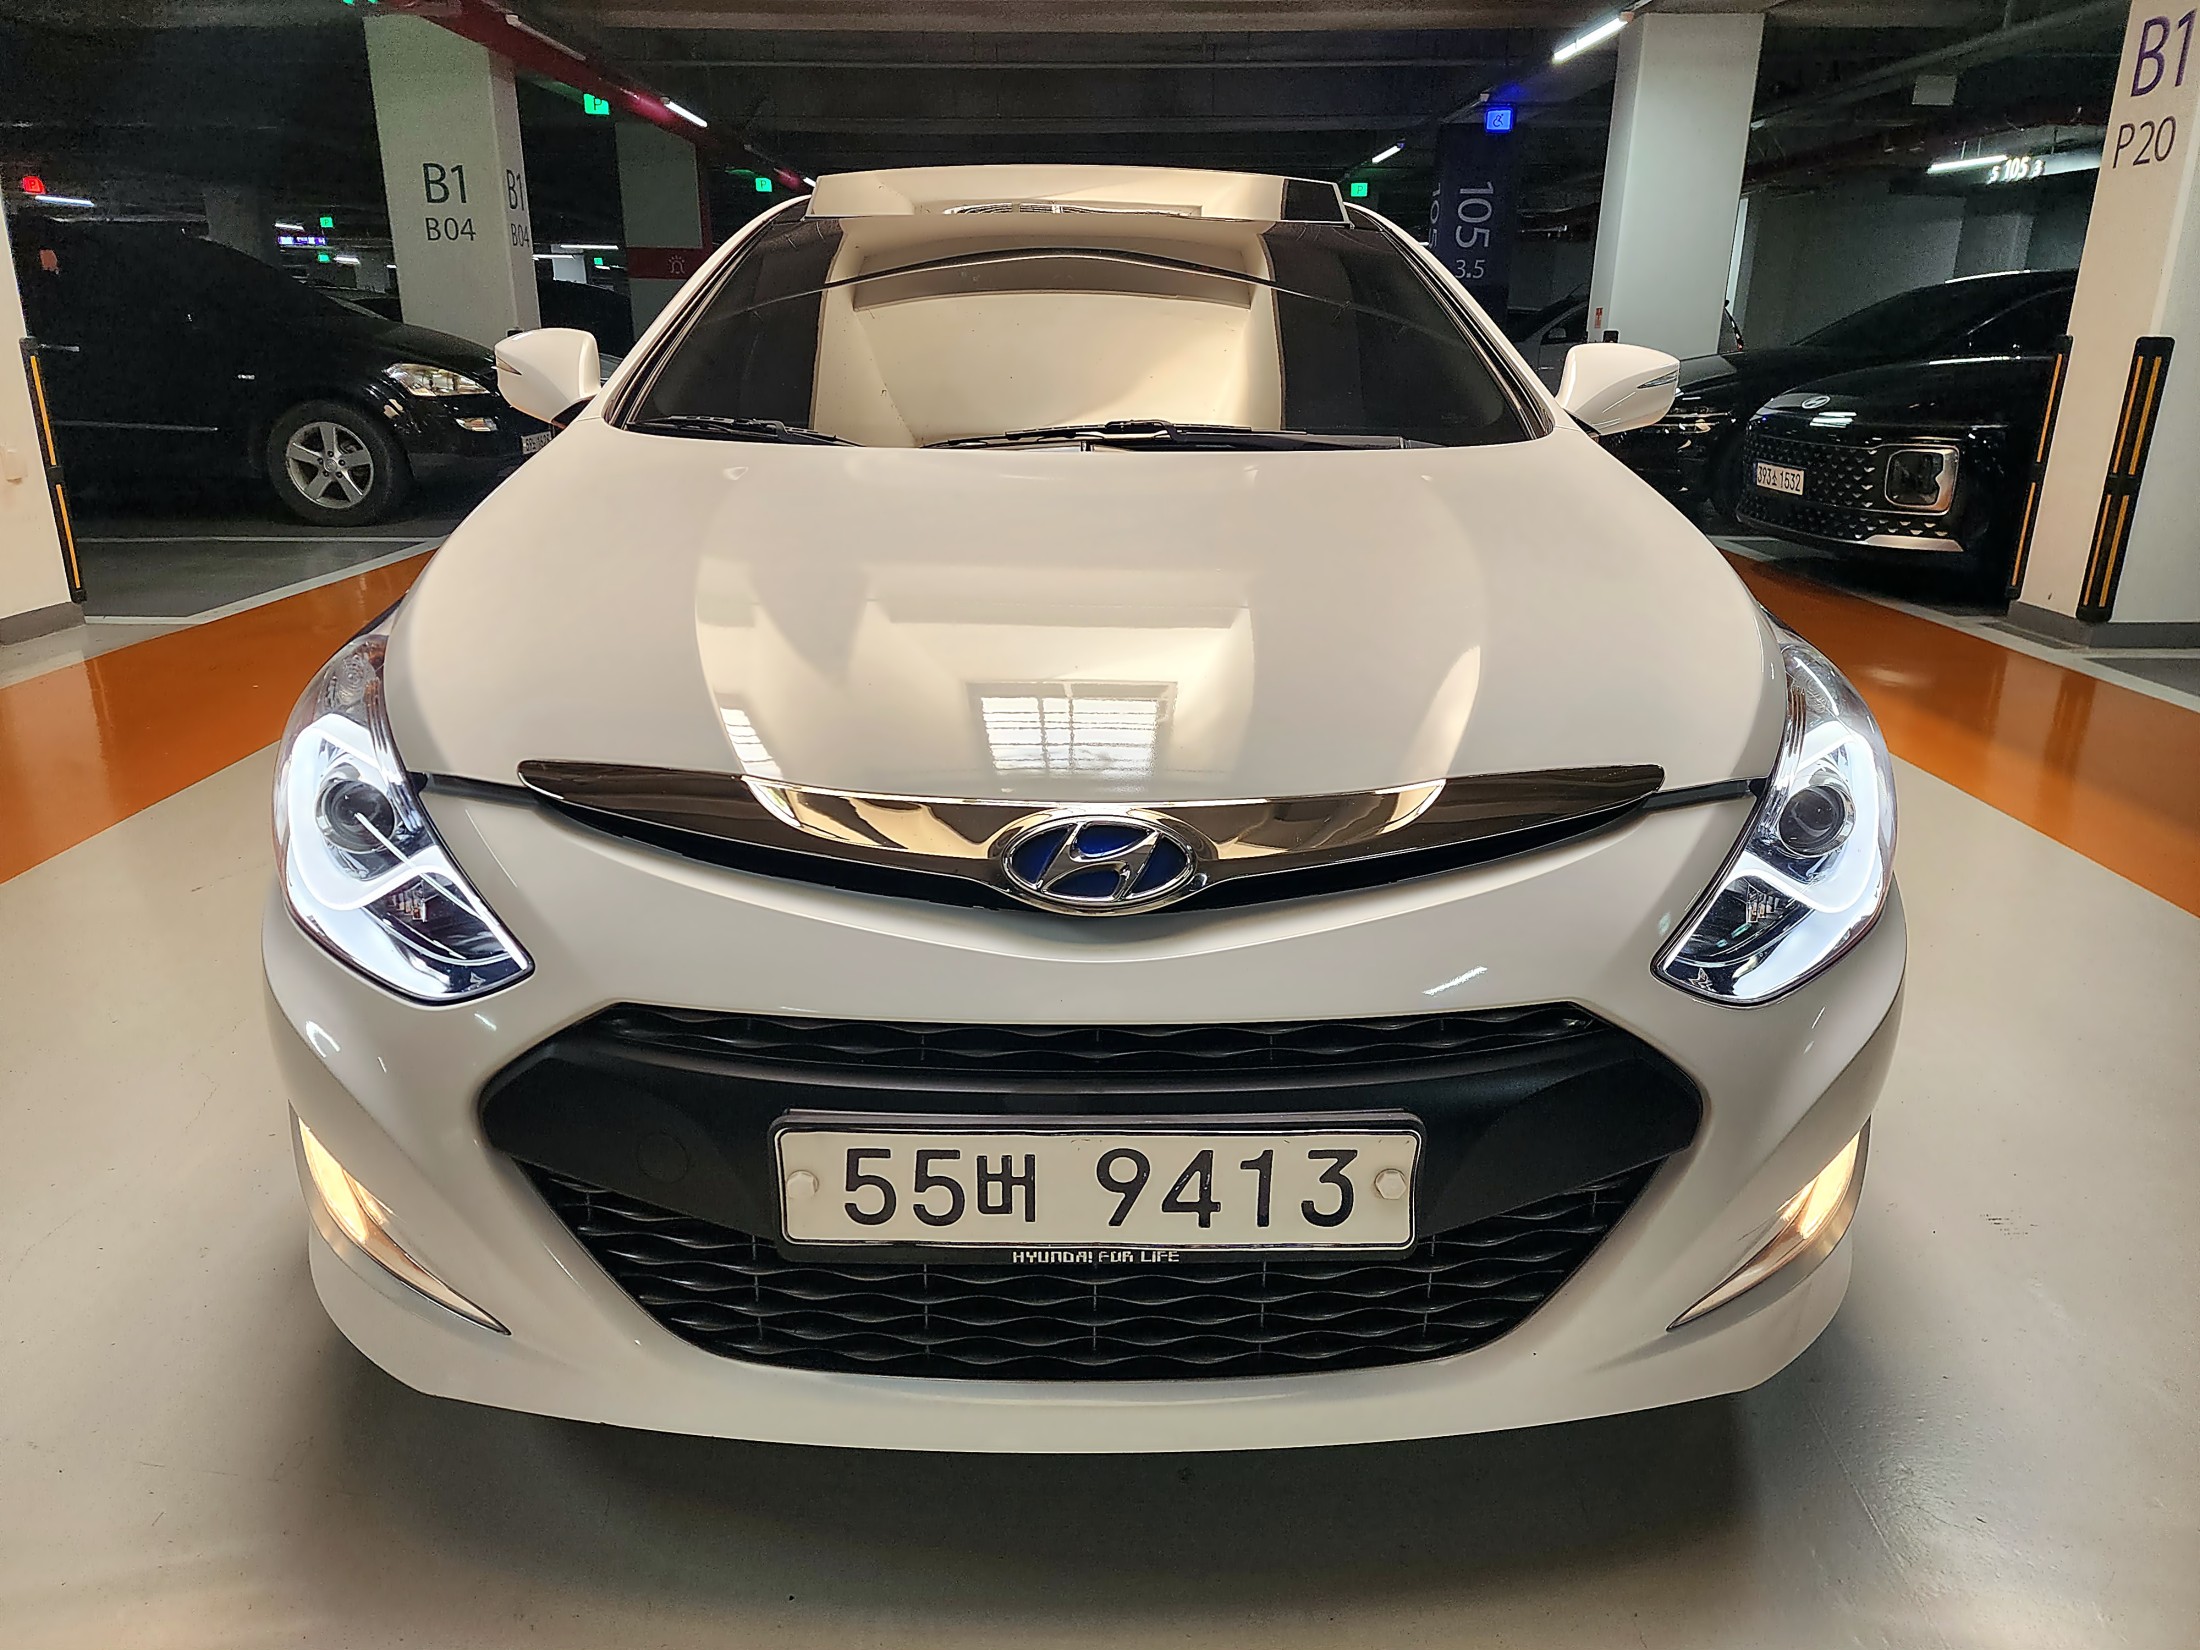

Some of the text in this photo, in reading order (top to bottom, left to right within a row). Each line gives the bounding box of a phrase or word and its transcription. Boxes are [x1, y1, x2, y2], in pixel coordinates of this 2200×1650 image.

[2130, 8, 2198, 97] B1
[2112, 115, 2177, 169] P20
[422, 163, 467, 204] B1
[506, 168, 525, 211] B1
[2003, 156, 2031, 182] 105
[425, 217, 477, 241] B04
[1455, 181, 1494, 248] 105
[510, 223, 530, 248] B04
[1780, 470, 1801, 492] 1532
[844, 1147, 1358, 1229] 55버 9413
[1098, 1250, 1134, 1264] FOR
[1140, 1250, 1180, 1263] LIFE
